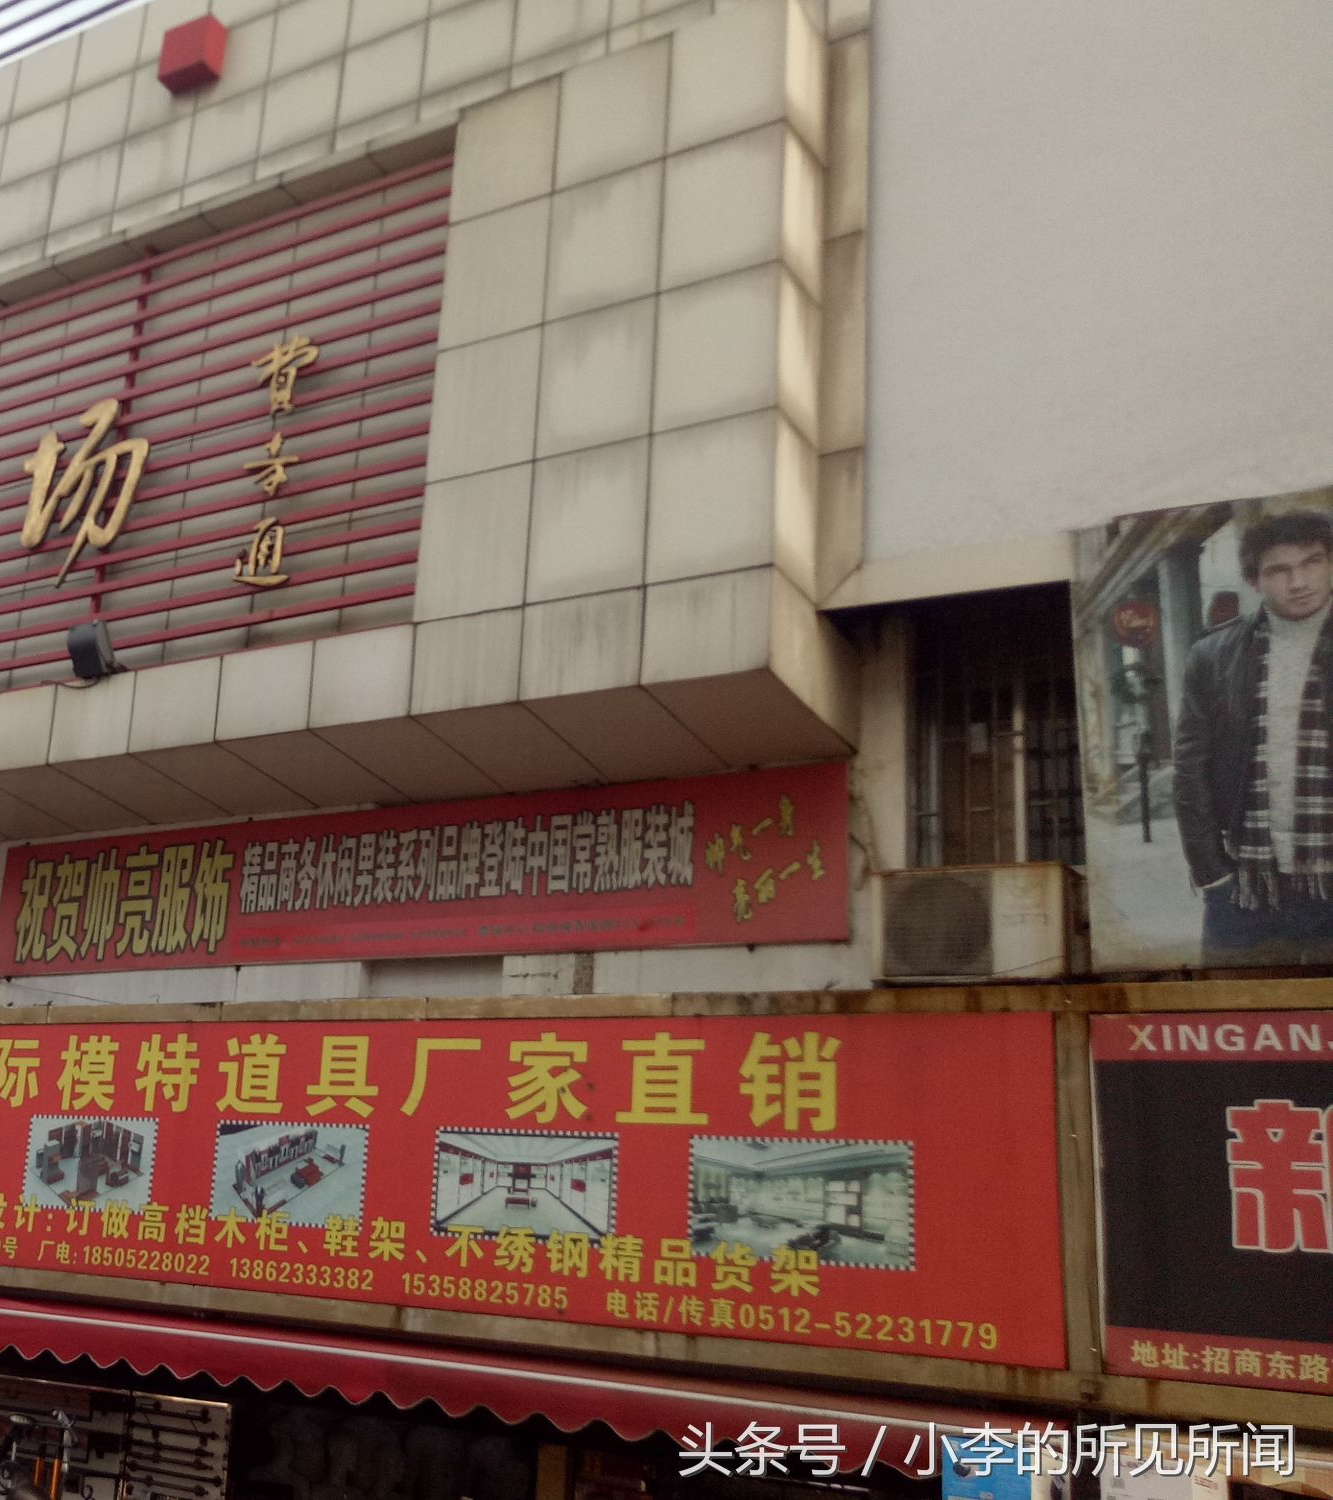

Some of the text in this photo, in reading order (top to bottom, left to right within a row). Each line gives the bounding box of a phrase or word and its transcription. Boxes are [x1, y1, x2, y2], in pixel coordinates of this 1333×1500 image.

[13, 838, 236, 964] 祝贺帅亮服饰
[1128, 1023, 1333, 1053] XINGAN
[228, 1256, 375, 1292] 13862333382
[401, 1271, 570, 1311] 15358825785
